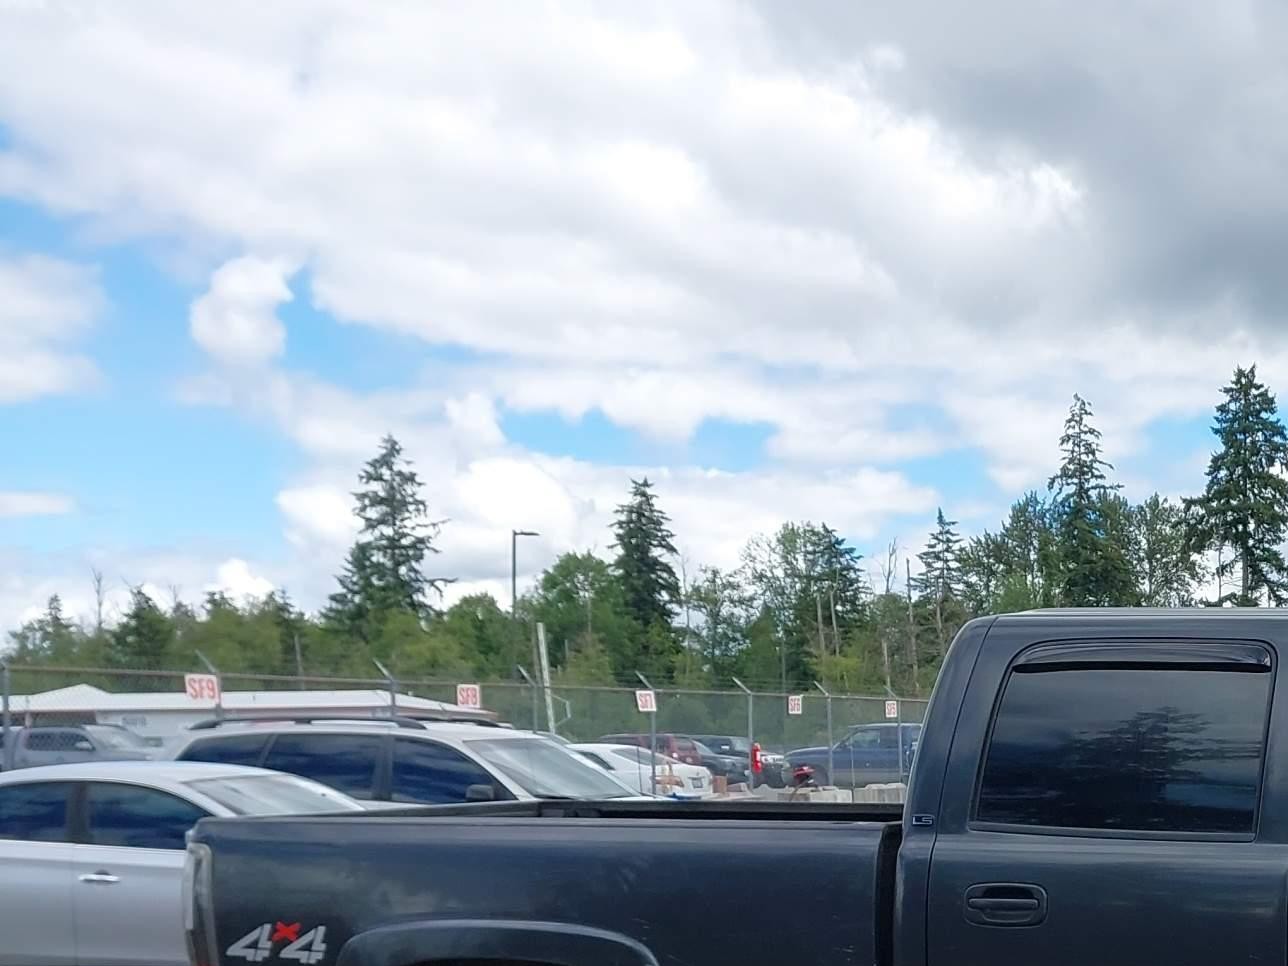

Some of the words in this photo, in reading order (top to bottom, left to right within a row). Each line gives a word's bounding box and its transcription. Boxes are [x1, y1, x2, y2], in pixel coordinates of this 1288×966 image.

[188, 678, 216, 700] SF9
[459, 688, 477, 705] SF8
[639, 693, 653, 709] SF7
[912, 815, 933, 825] LS
